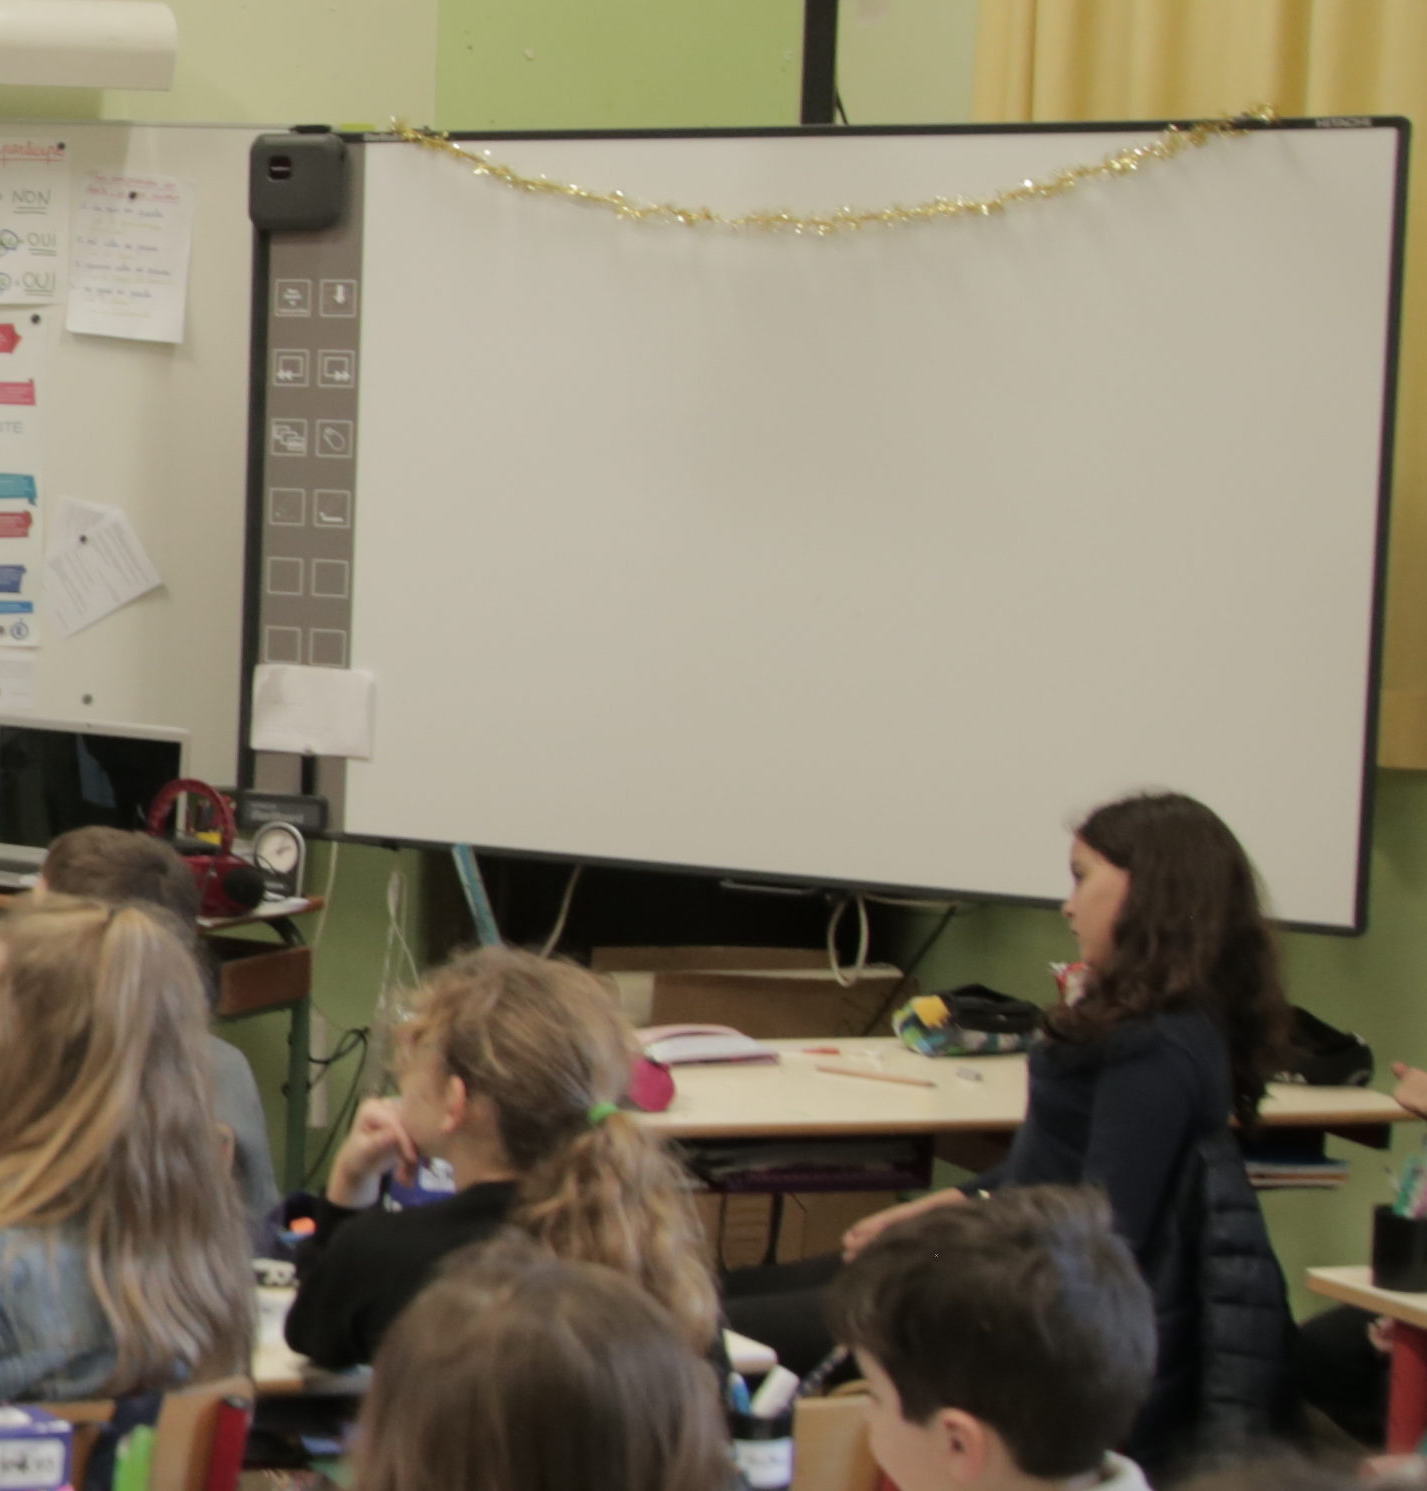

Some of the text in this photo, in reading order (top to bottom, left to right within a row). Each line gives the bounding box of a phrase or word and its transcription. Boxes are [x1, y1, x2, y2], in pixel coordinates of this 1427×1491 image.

[11, 188, 53, 208] NON
[26, 231, 58, 248] OUI
[21, 271, 57, 290] OUI
